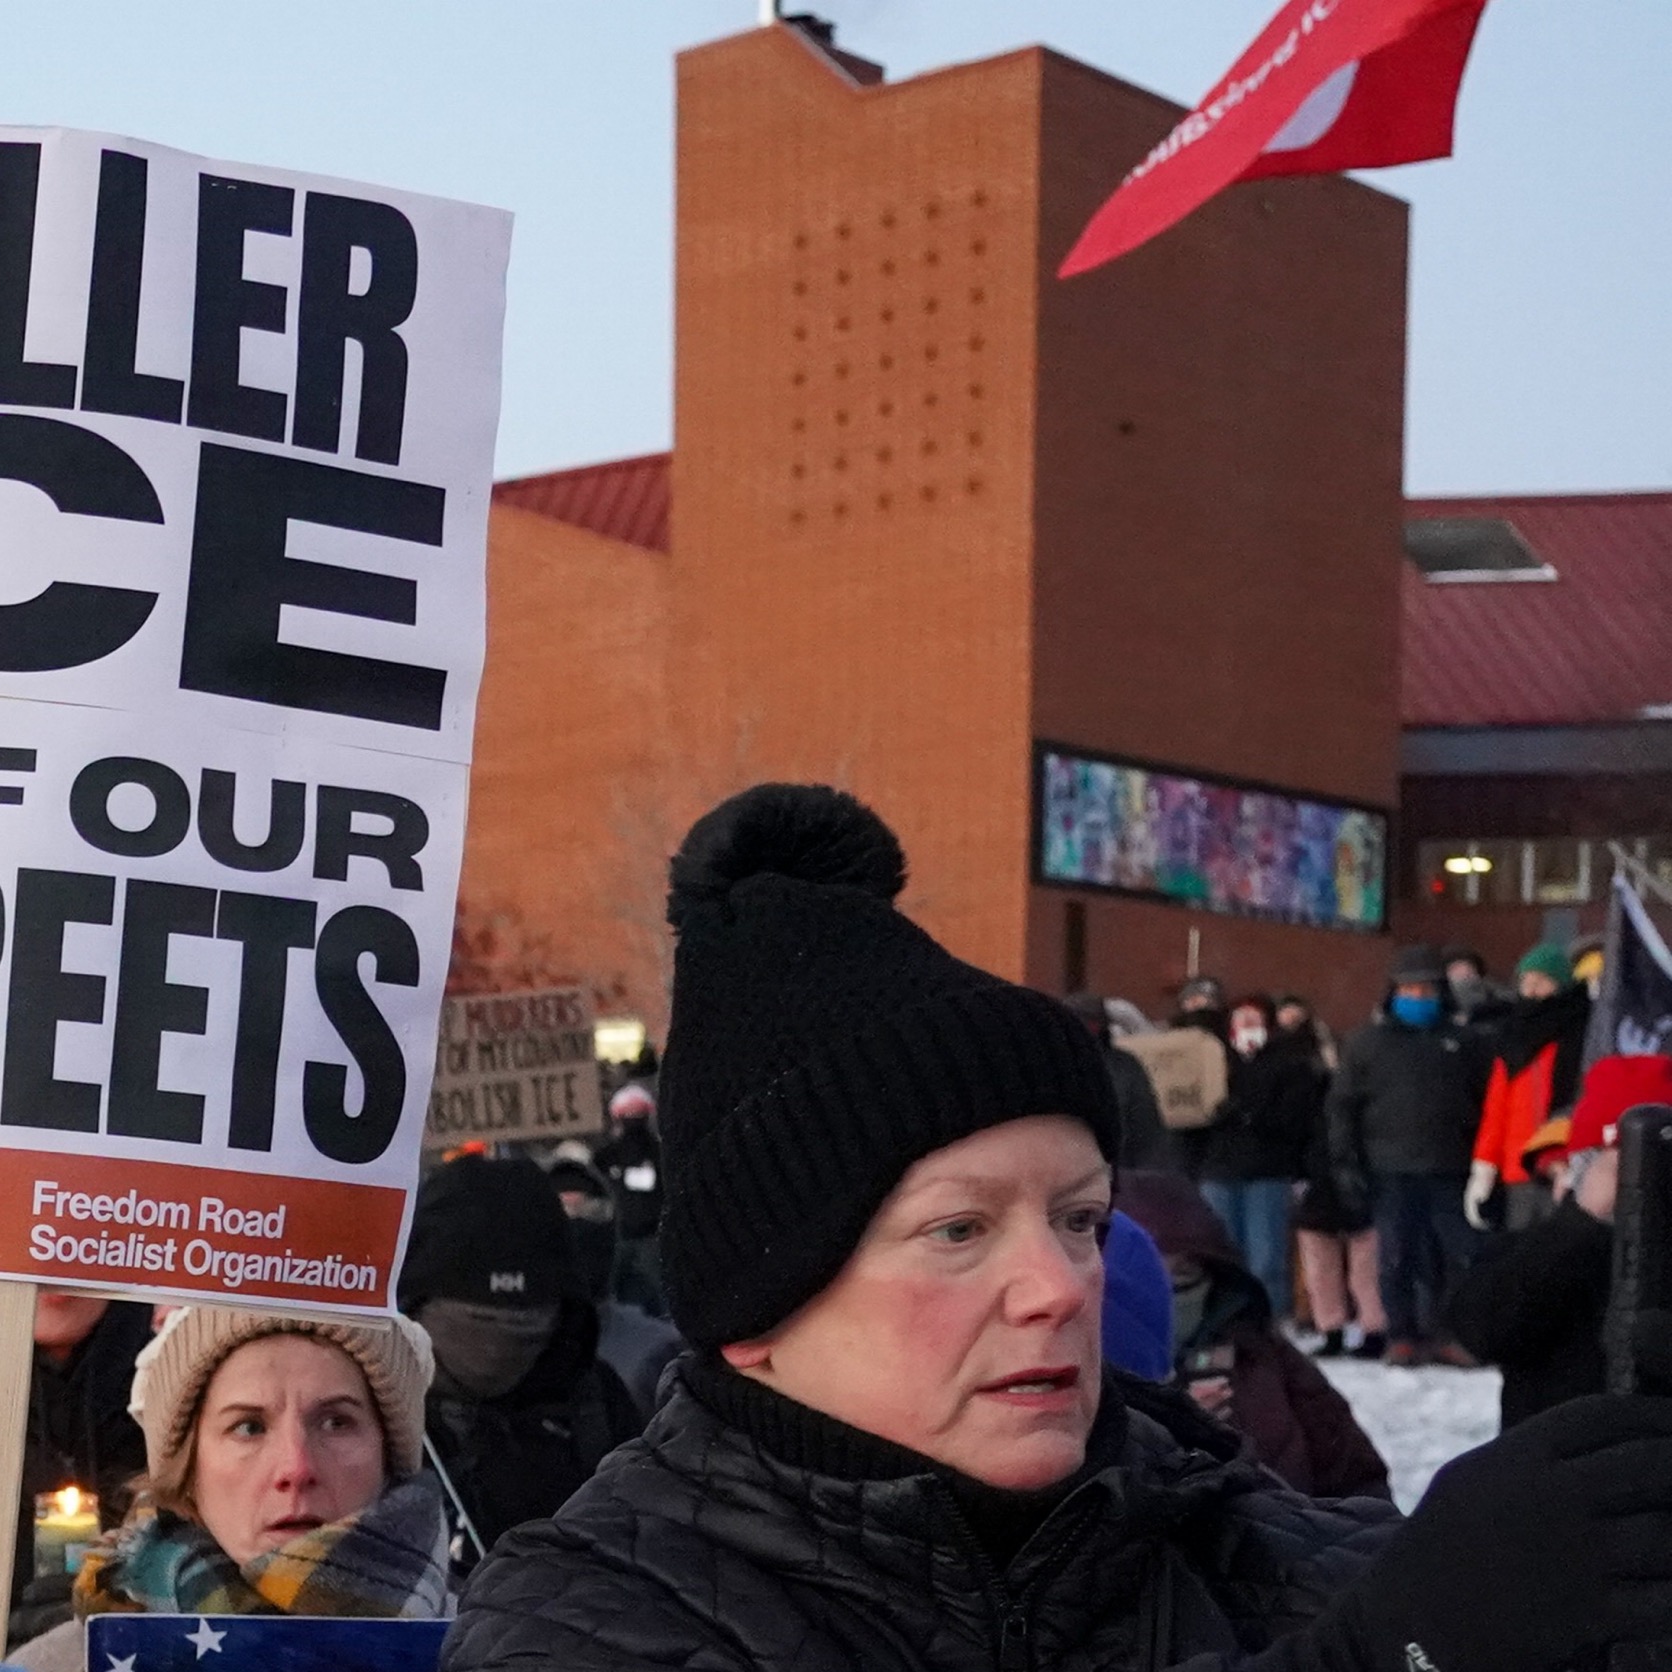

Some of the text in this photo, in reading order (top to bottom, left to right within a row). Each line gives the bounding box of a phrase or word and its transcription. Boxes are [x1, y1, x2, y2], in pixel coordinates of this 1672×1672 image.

[69, 756, 429, 892] OUR
[531, 1072, 580, 1126] ICE
[32, 1180, 286, 1239] Freedom Road
[29, 1224, 377, 1291] Socialist Organization
